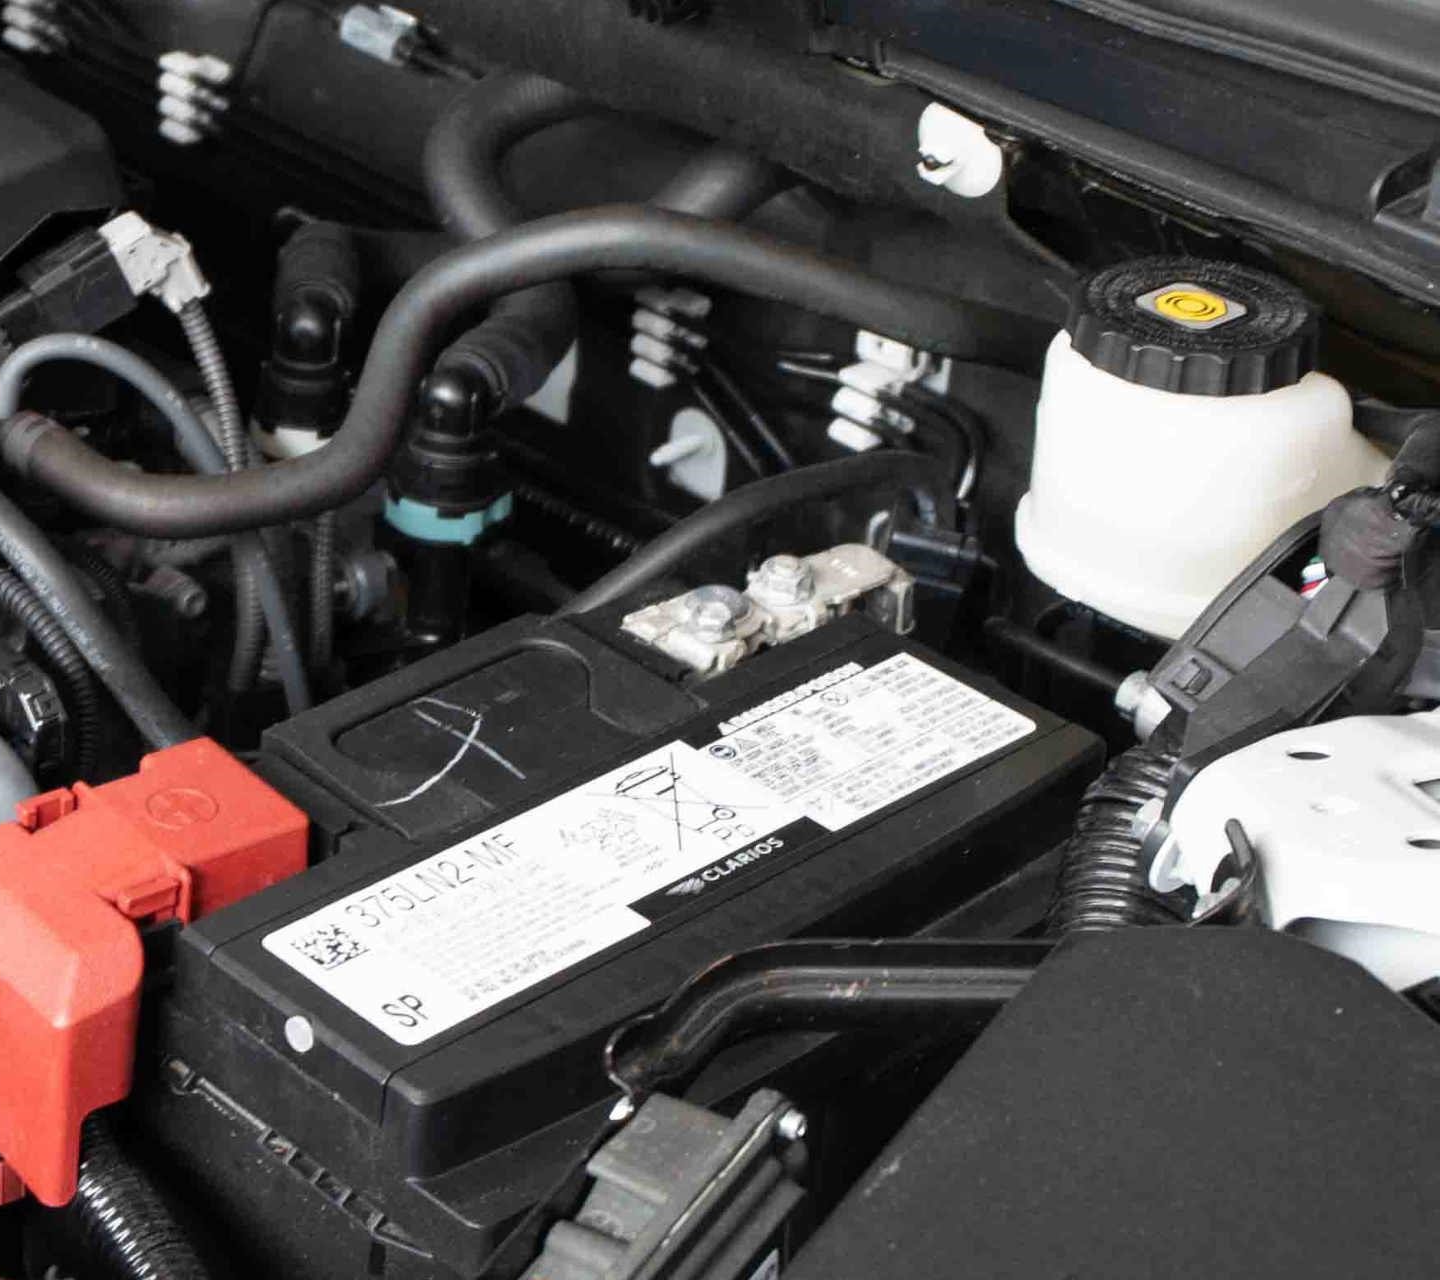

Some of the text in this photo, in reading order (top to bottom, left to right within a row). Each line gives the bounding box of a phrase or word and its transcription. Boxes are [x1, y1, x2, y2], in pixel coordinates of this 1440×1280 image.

[344, 832, 519, 928] 375LN2-MF
[700, 836, 785, 882] CLARIOS
[381, 993, 429, 1028] SP
